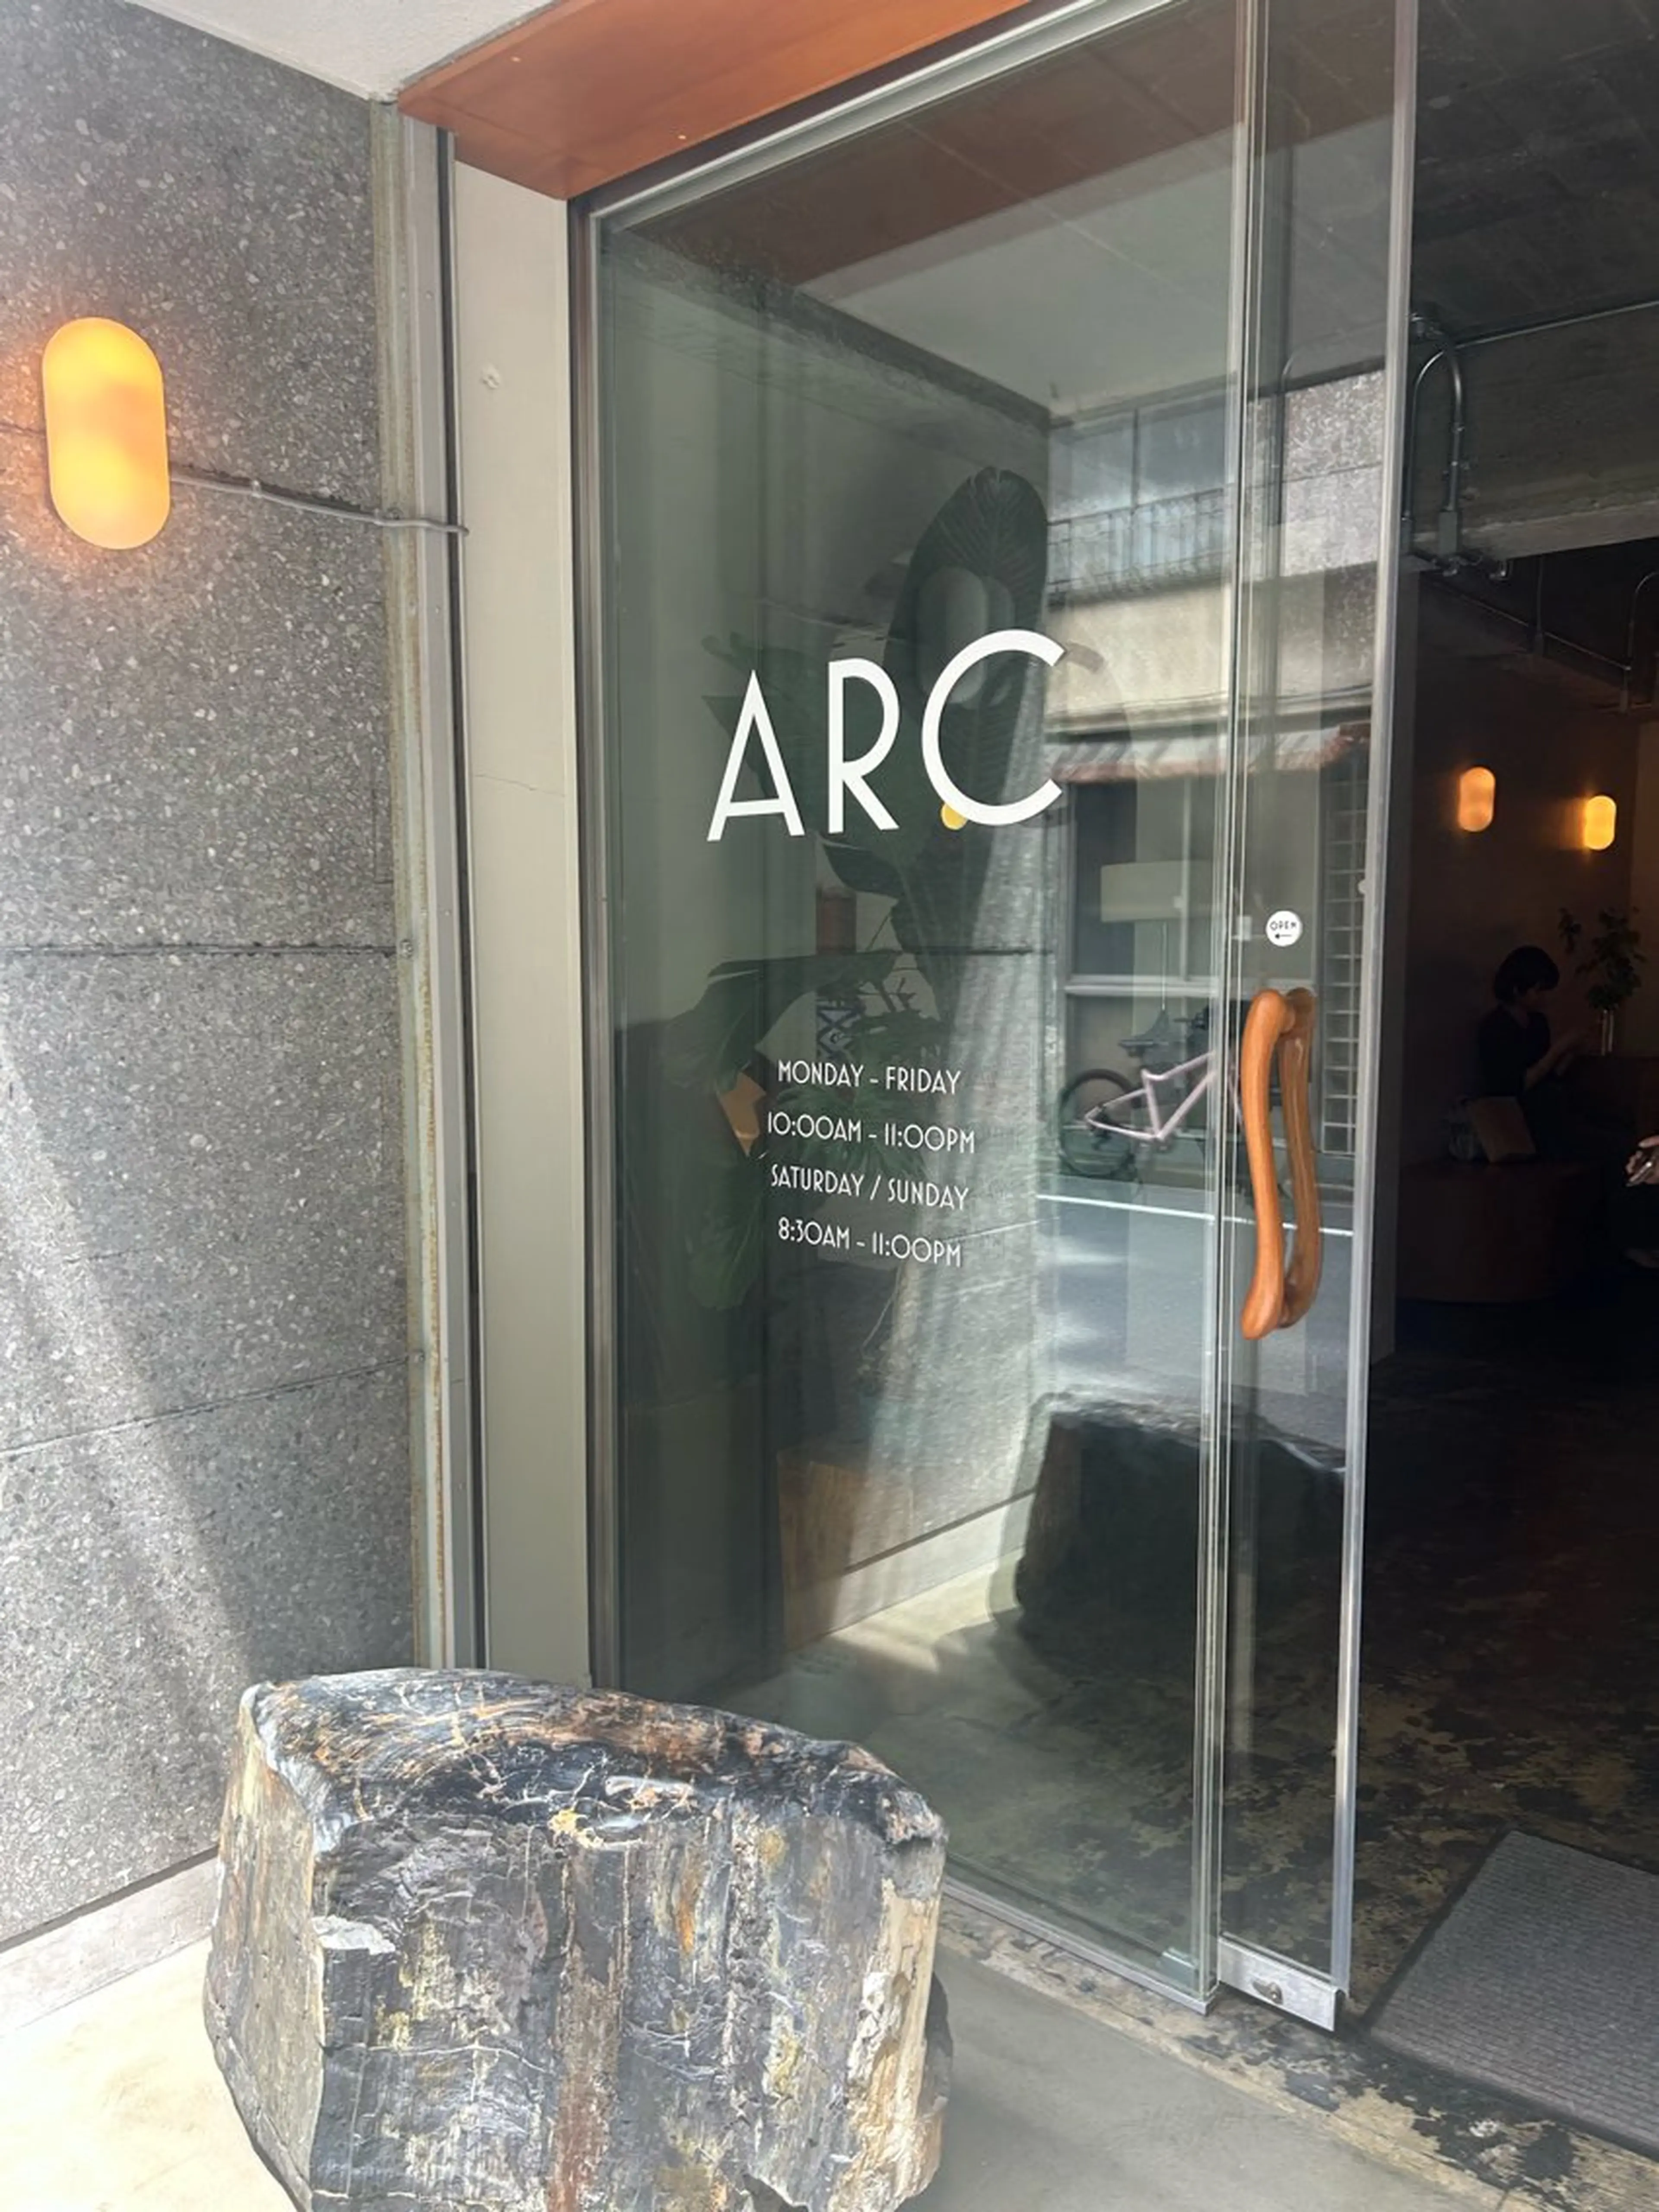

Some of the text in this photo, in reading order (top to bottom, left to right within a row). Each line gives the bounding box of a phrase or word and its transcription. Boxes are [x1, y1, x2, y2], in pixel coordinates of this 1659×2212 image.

[707, 629, 1066, 842] ARC
[1270, 920, 1297, 931] OPEN
[778, 1060, 864, 1087] MONDAY
[886, 1066, 961, 1094] FRIDAY
[768, 1111, 861, 1143] 10:00AM
[885, 1122, 974, 1154] 11:00PM
[771, 1163, 969, 1210] SATURDAY / SUNDAY
[778, 1217, 849, 1249] 8:30AM
[872, 1232, 961, 1266] 11:00PM
